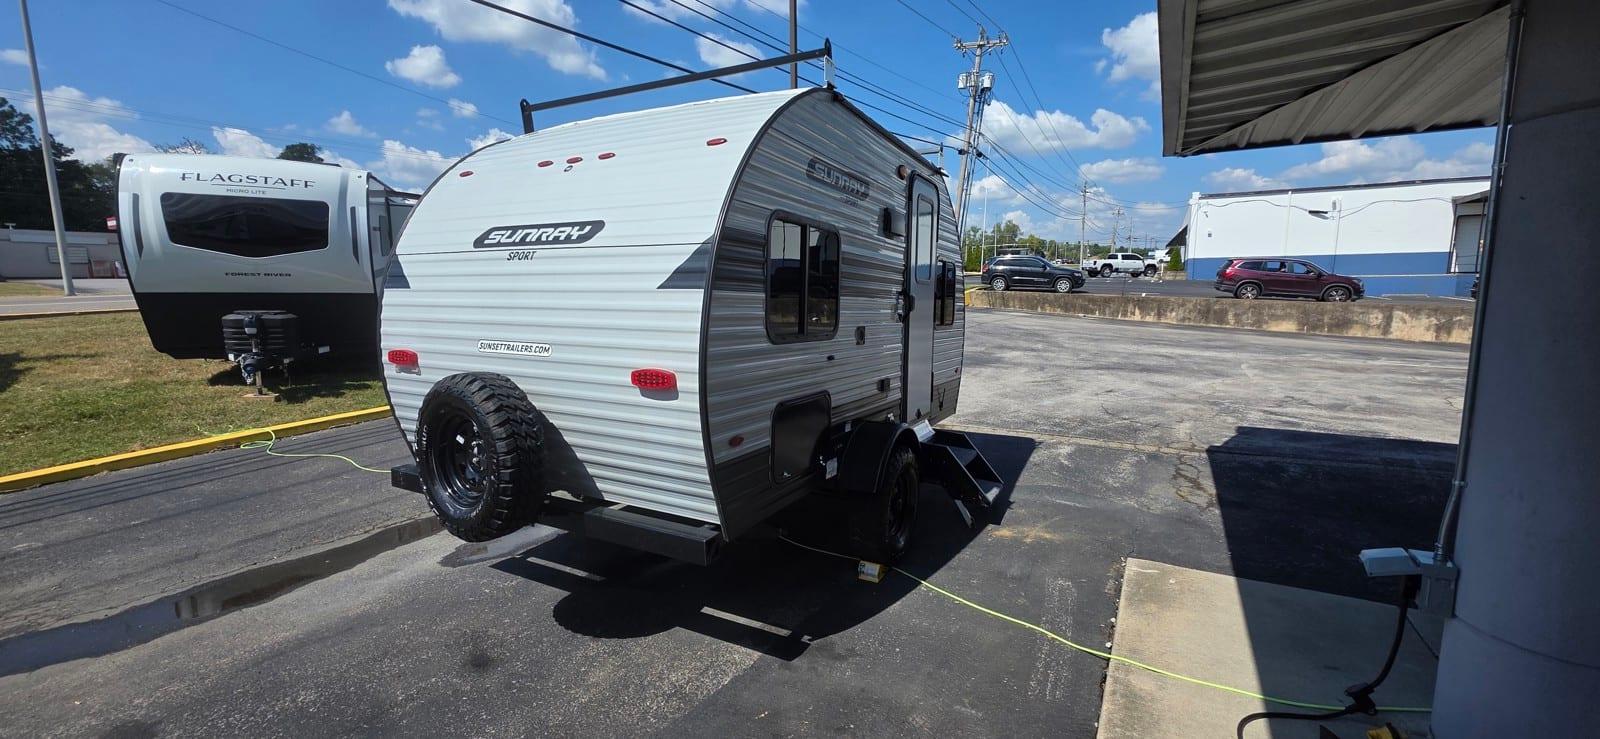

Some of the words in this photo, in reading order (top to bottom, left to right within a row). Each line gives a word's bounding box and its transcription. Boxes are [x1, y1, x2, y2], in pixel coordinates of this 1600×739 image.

[180, 172, 316, 189] FLAGSTAFF
[814, 162, 866, 196] SUNRAY
[484, 225, 592, 244] SUNRAY
[506, 251, 537, 261] SPORT
[478, 341, 551, 354] SUNSETTRAILERS.COM
